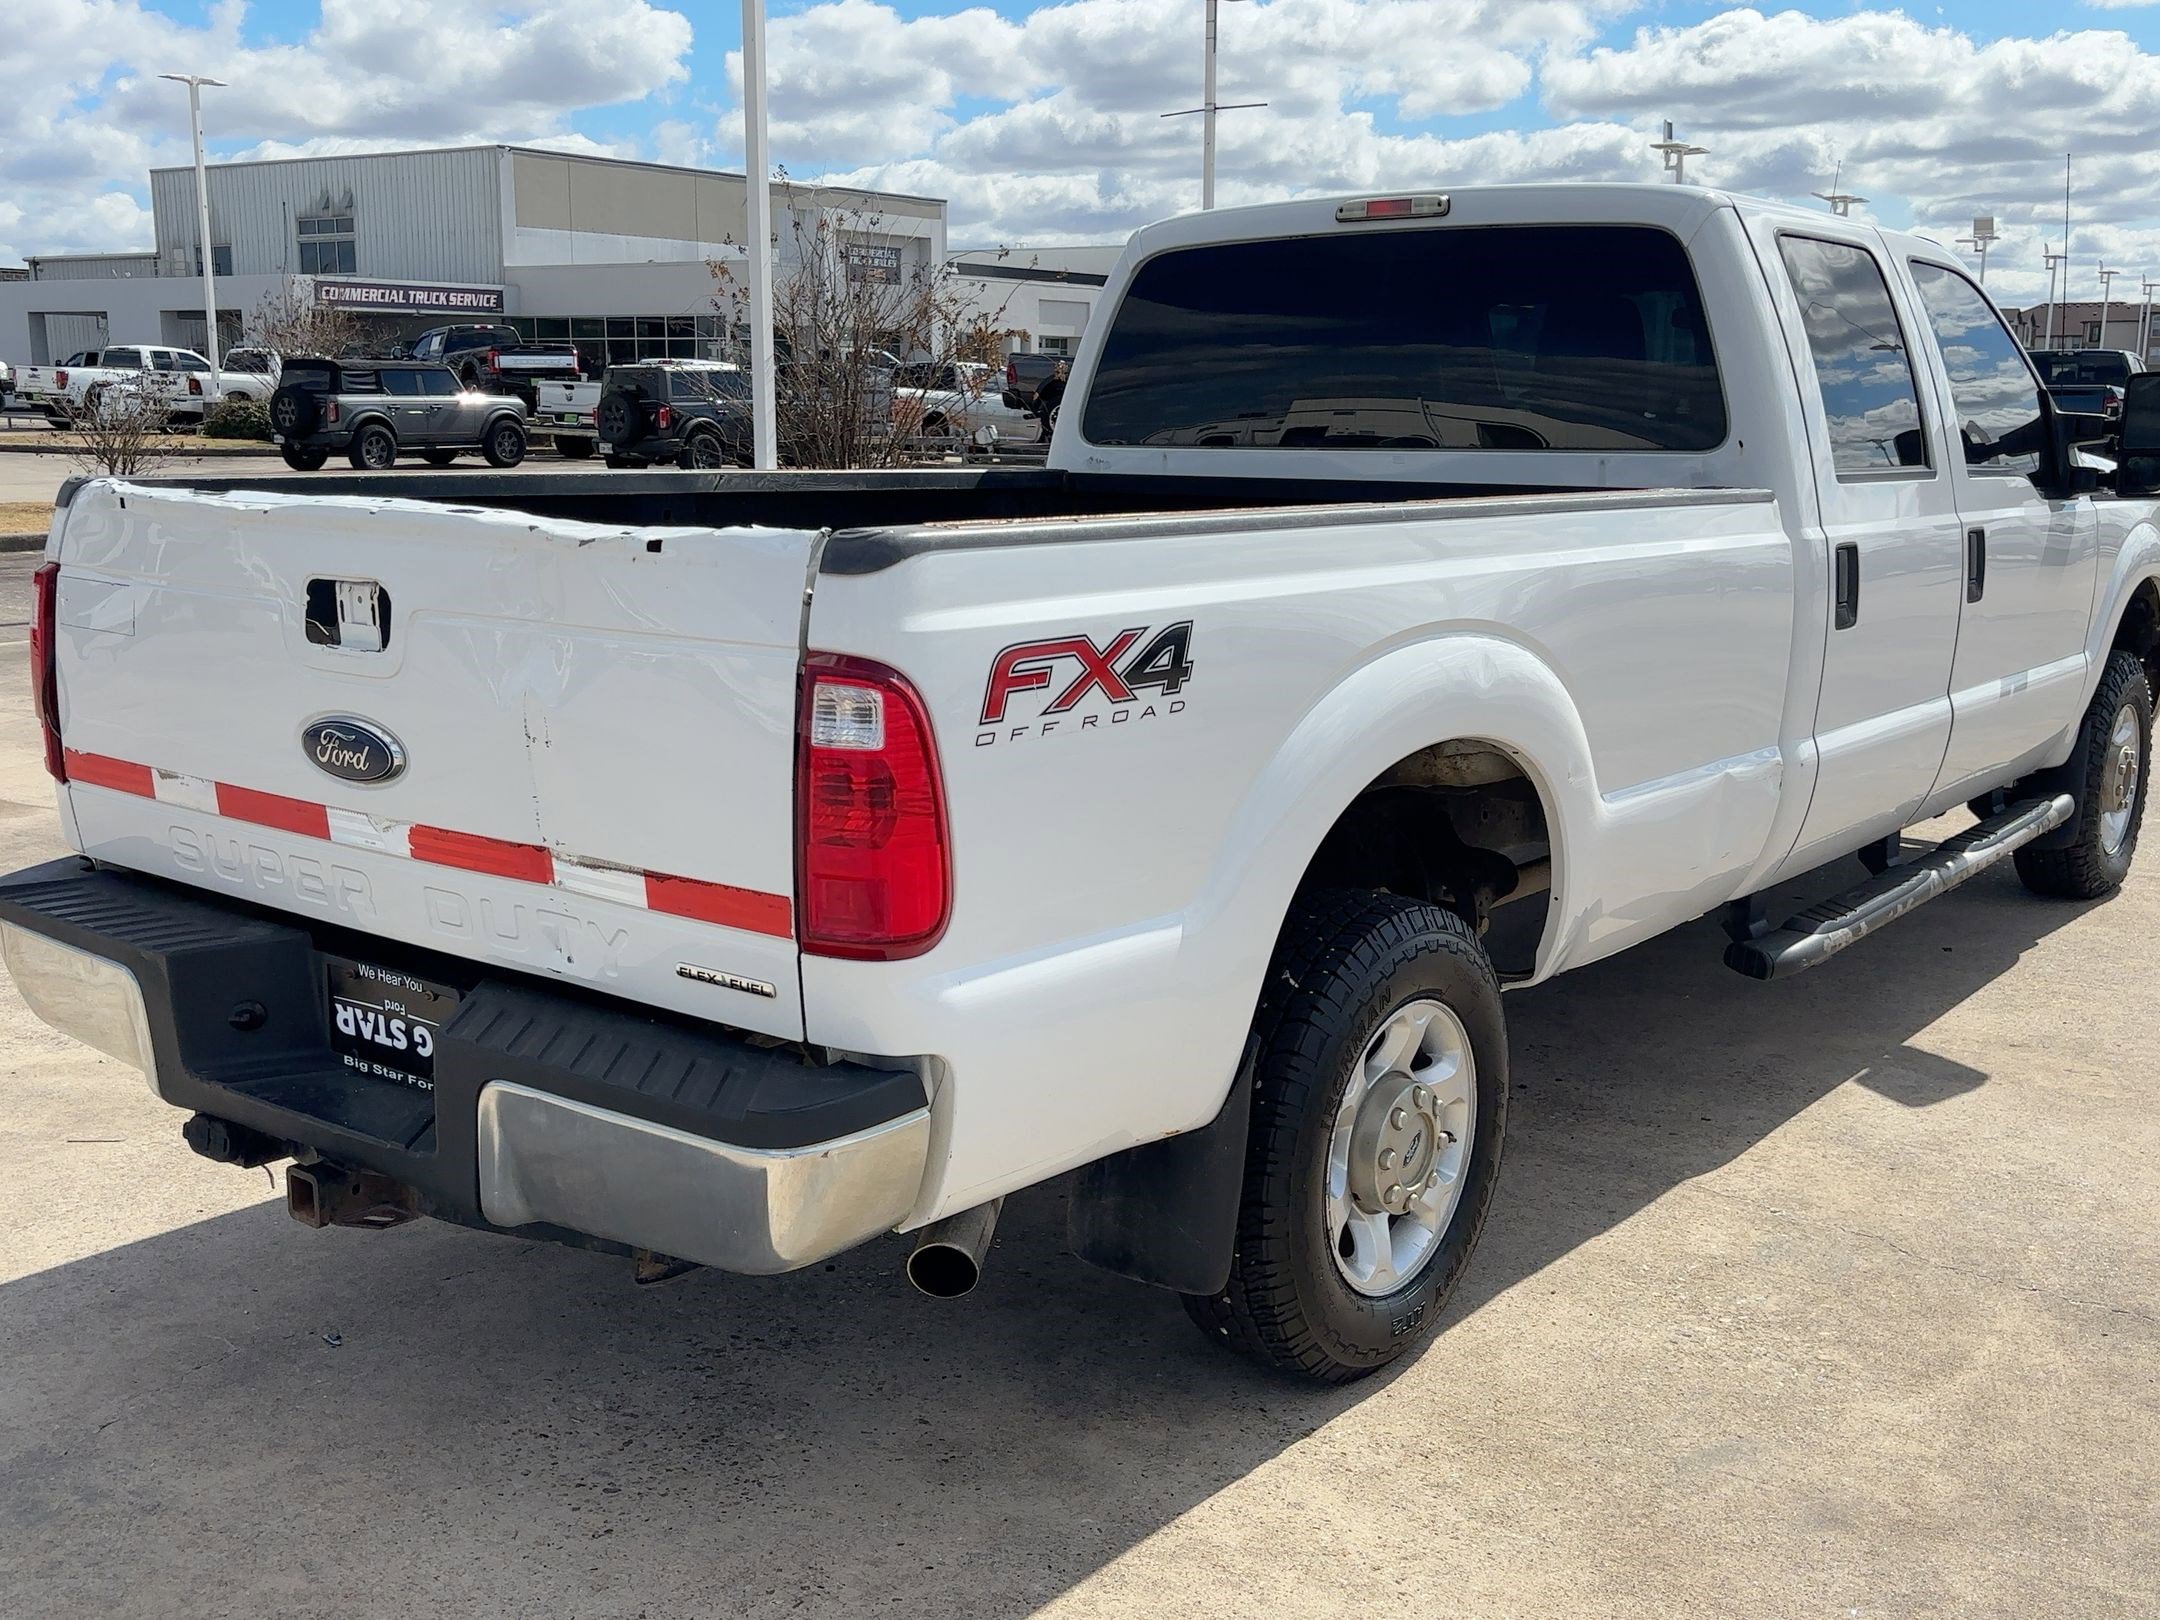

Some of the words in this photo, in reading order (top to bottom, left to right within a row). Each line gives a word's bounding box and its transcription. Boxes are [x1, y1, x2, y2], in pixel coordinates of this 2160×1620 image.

[322, 286, 406, 304] COMMERCIAL
[408, 290, 448, 305] TRUCK
[449, 292, 497, 307] SERVICE
[979, 620, 1194, 725] FX4
[975, 721, 1060, 747] OFF
[1081, 700, 1186, 730] ROAD
[316, 728, 370, 771] Ford
[167, 824, 378, 918] SUPER
[423, 885, 630, 978] DUTY
[358, 963, 376, 980] We
[377, 968, 401, 987] Hear
[403, 975, 423, 993] You
[679, 966, 719, 985] FLEX
[729, 978, 774, 998] FUEL
[334, 1003, 408, 1050] STAR
[384, 999, 406, 1016] Ford
[343, 1055, 369, 1073] Big
[372, 1063, 404, 1082] Star
[407, 1074, 434, 1091] For
[1320, 985, 1392, 1131] IRONMAN
[1390, 1300, 1427, 1336] AT2
